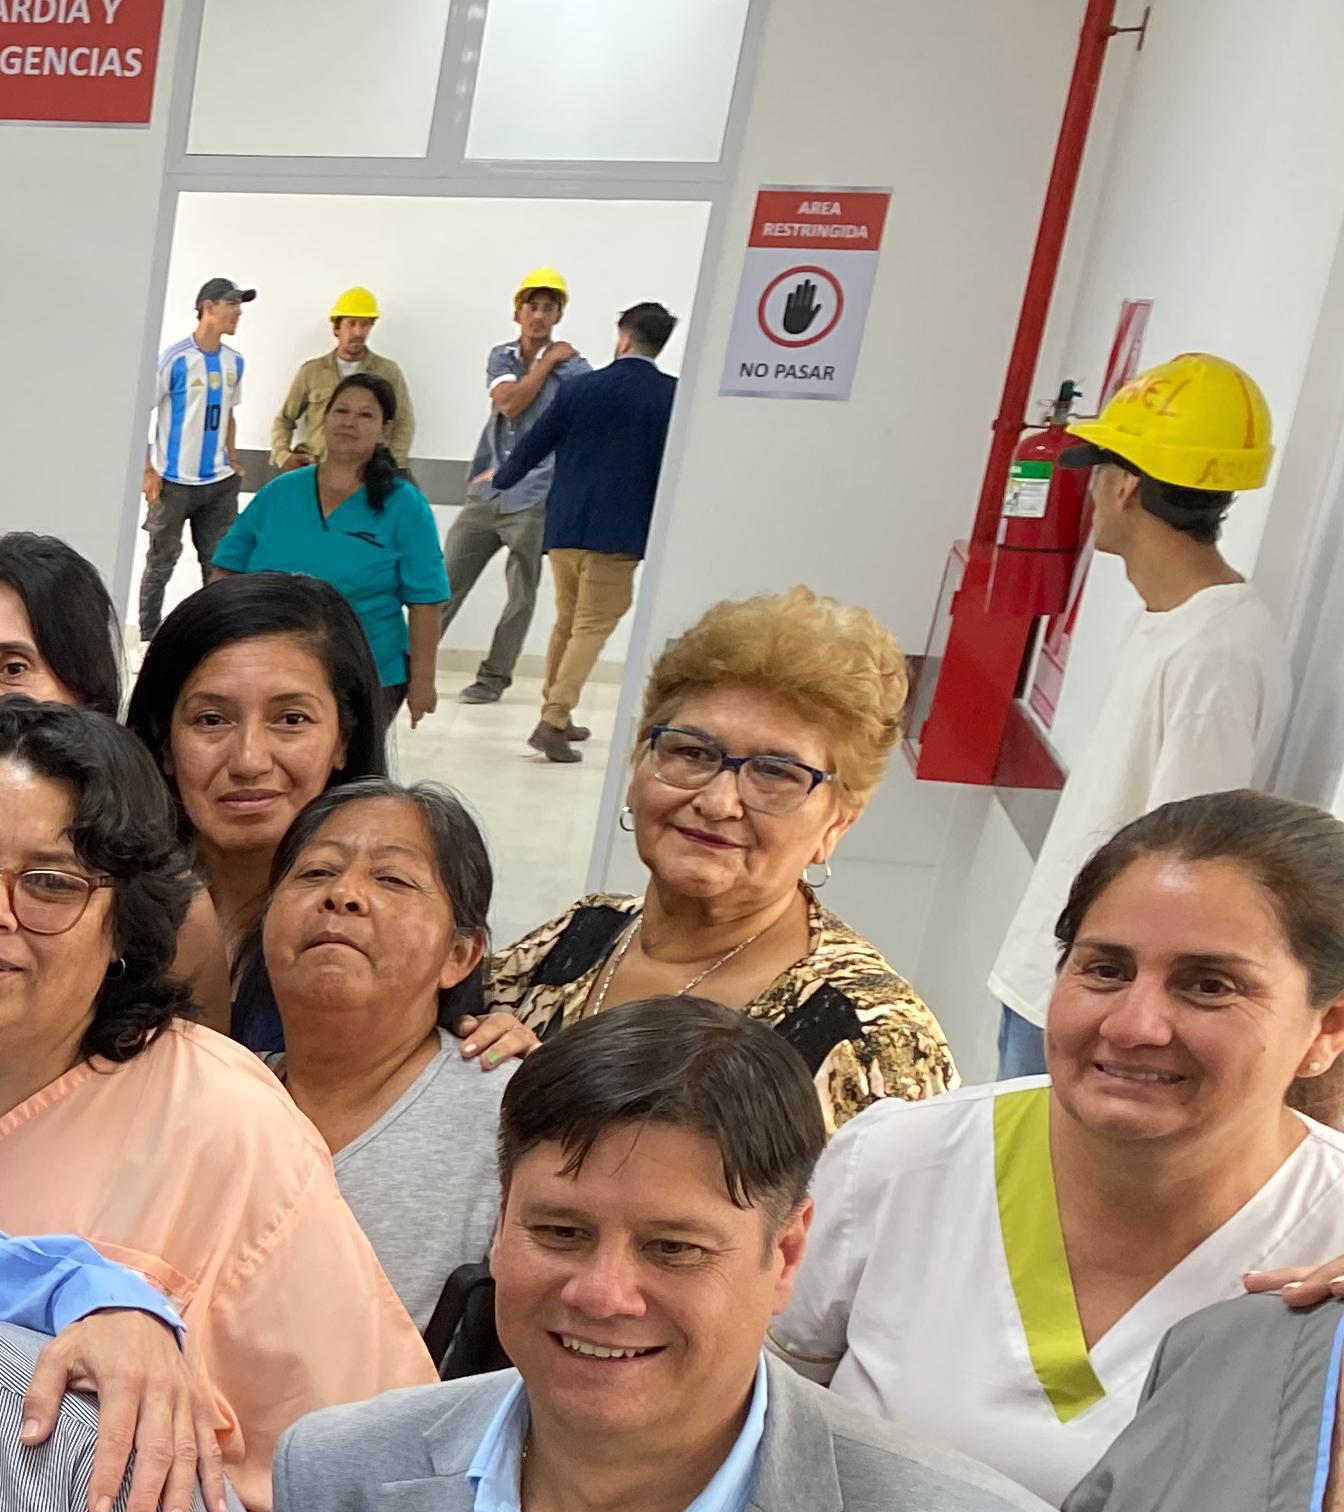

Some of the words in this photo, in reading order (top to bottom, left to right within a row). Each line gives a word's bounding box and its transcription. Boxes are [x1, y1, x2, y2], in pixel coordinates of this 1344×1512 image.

[103, 0, 122, 24] Y
[797, 201, 842, 216] AREA
[762, 222, 868, 239] RESTRINGIDA
[739, 362, 768, 378] NO
[774, 364, 835, 381] PASAR
[204, 404, 221, 432] 10
